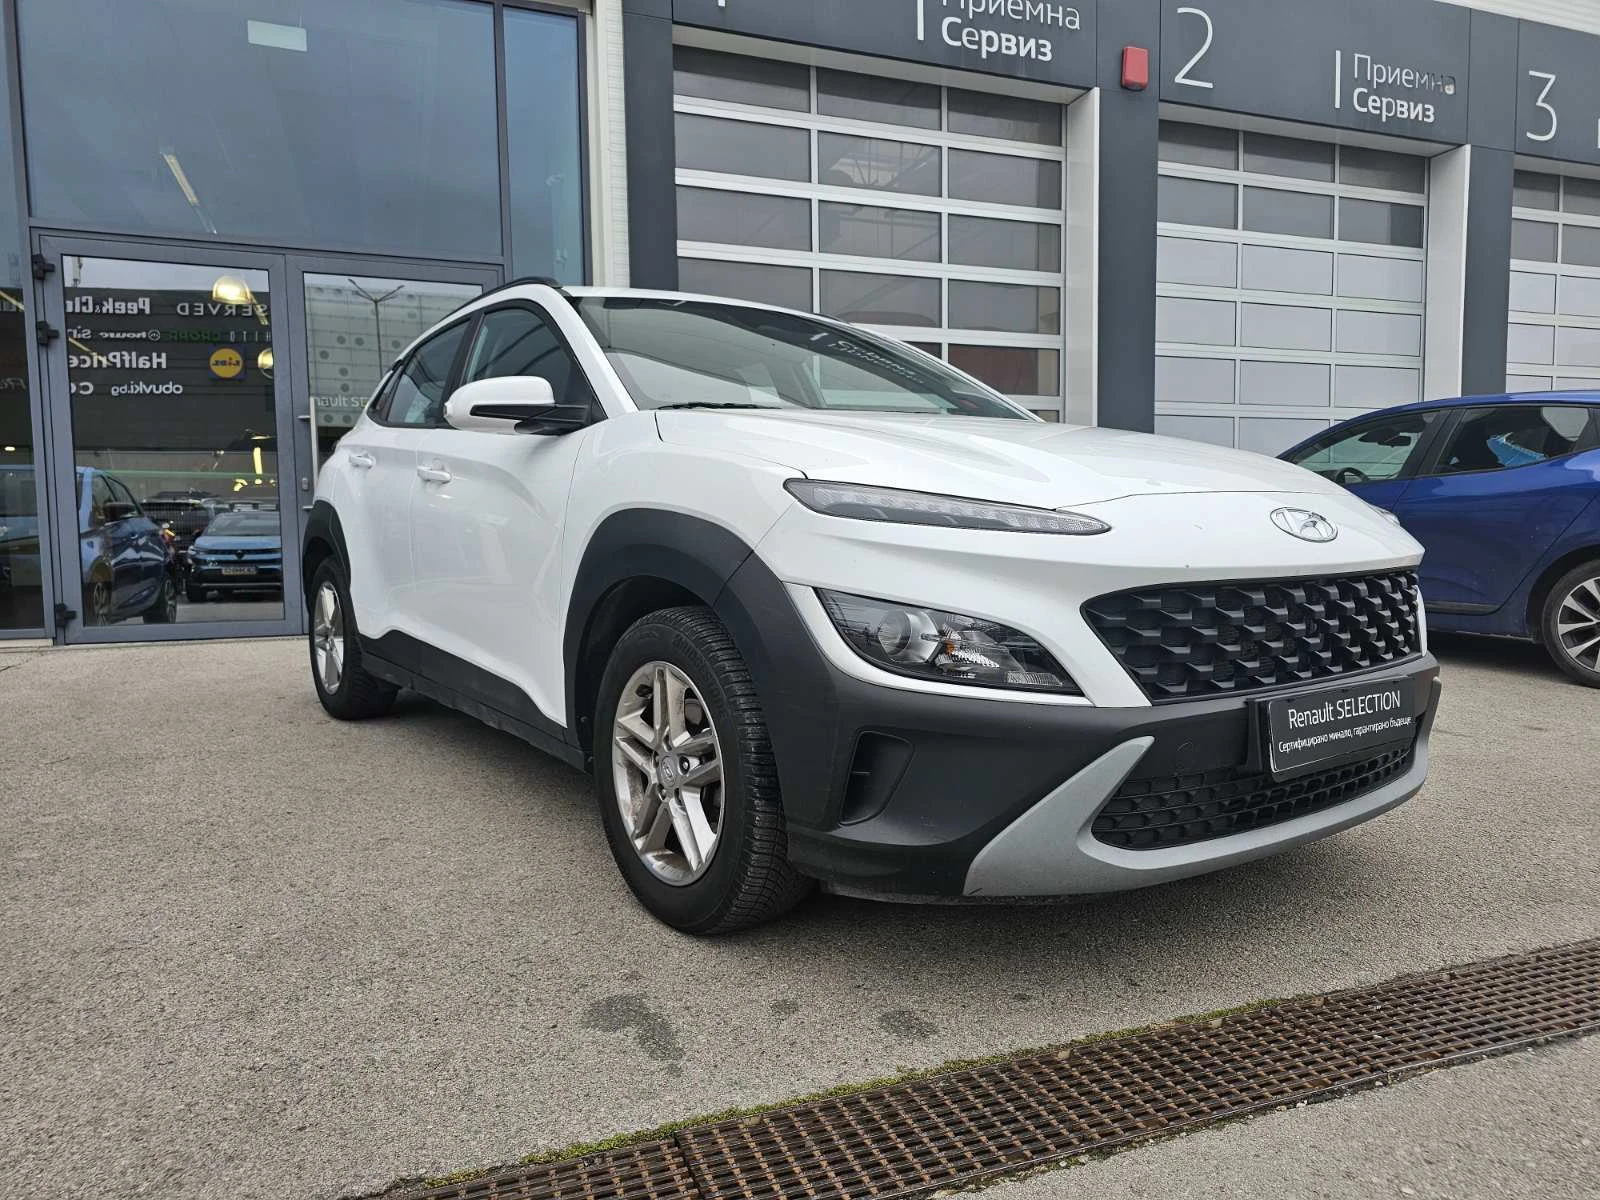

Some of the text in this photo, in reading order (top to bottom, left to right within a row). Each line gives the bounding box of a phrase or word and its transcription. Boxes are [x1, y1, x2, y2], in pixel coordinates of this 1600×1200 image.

[943, 0, 1080, 30] риемна
[942, 16, 1053, 62] Сервиз
[1174, 7, 1214, 89] 2
[1353, 87, 1435, 123] Сервиз
[1526, 70, 1558, 141] 3
[1288, 690, 1401, 729] Renault SELECTION
[1279, 733, 1329, 754] Сертифицирано
[1353, 721, 1390, 737] гарантирано
